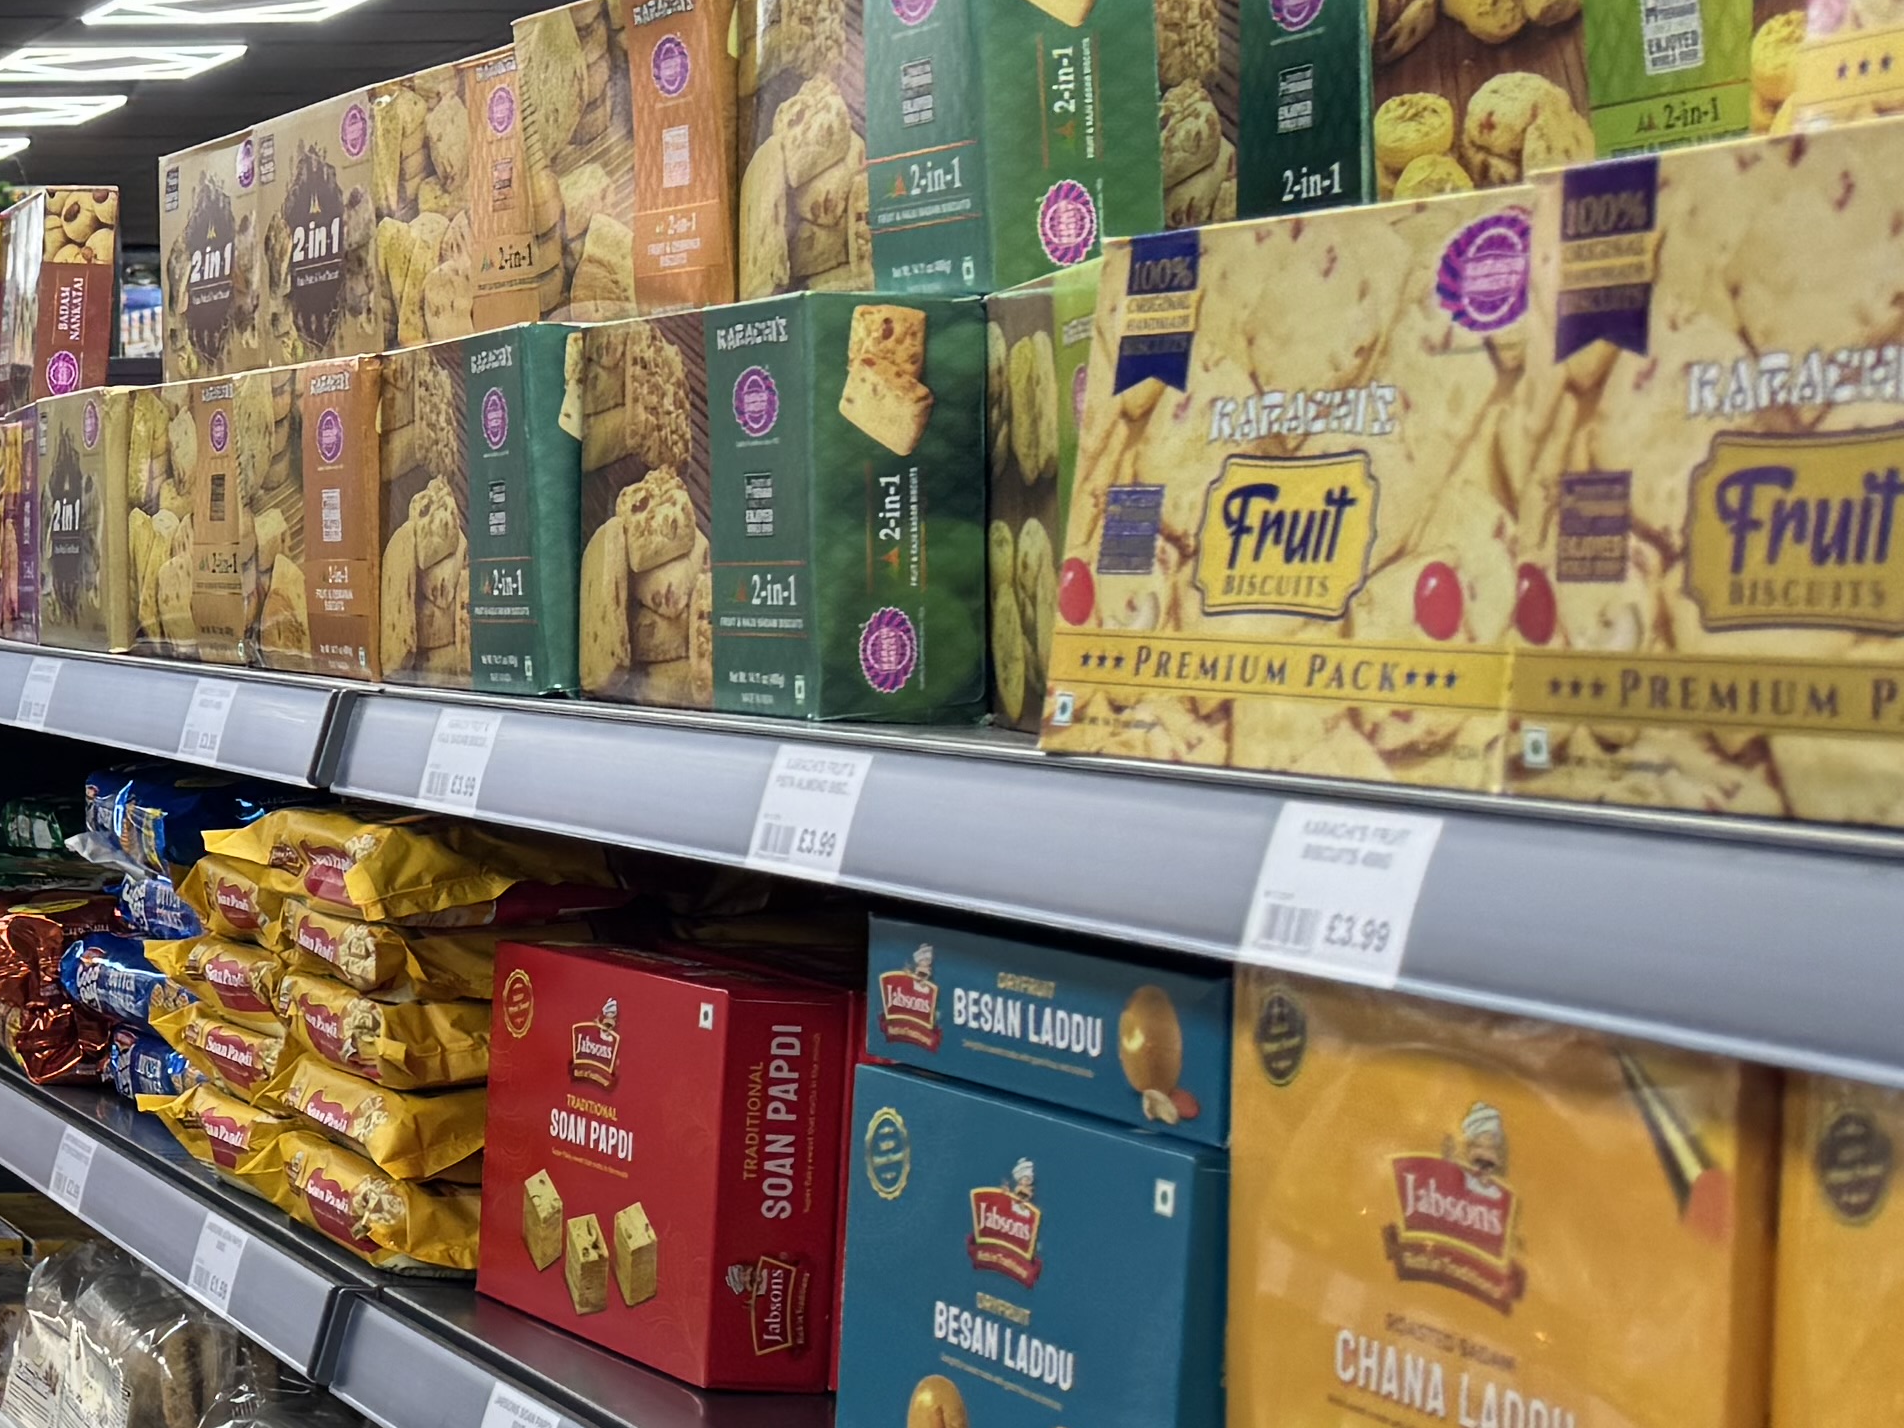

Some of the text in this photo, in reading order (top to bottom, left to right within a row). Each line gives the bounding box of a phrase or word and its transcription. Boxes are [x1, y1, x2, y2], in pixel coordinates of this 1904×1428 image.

[1053, 46, 1075, 114] 2-in-1
[1663, 97, 1719, 129] 2-in-1
[910, 156, 962, 196] 2-in-1
[1282, 162, 1341, 201] 2-in-1
[1132, 257, 1192, 291] 100%
[58, 287, 69, 331] BADAM
[716, 317, 788, 349] KARACHI'S
[1210, 382, 1396, 443] KARACHI'S
[879, 474, 901, 540] 2-in-1
[1223, 483, 1357, 570] Fruit
[1716, 465, 1904, 573] Fruit
[493, 569, 522, 596] 2-in-1
[751, 575, 796, 605] 2-in-1
[1222, 574, 1328, 597] BISCUITS
[1729, 578, 1885, 607] BISCUITS
[1136, 646, 1398, 690] PREMIUM PACK
[1619, 669, 1839, 718] PREMIUM
[797, 827, 836, 858] £3.99
[1324, 913, 1389, 955] £3.99
[885, 988, 932, 1019] Jabsons
[953, 986, 1023, 1036] BESAN
[1027, 1005, 1102, 1058] LADDU
[566, 1094, 617, 1121] TRADITIONAL
[742, 1060, 765, 1181] TRADITIONAL
[761, 1025, 803, 1219] SOAN PAPDI
[549, 1108, 586, 1143] SOAN
[590, 1124, 633, 1163] PAPDI
[977, 1199, 1037, 1238] Jabsons
[1404, 1173, 1502, 1238] Jabsons
[764, 1268, 785, 1343] Jabsons
[933, 1301, 999, 1359] BESAN
[1003, 1330, 1074, 1391] LADDU
[1334, 1328, 1444, 1419] CHANA
